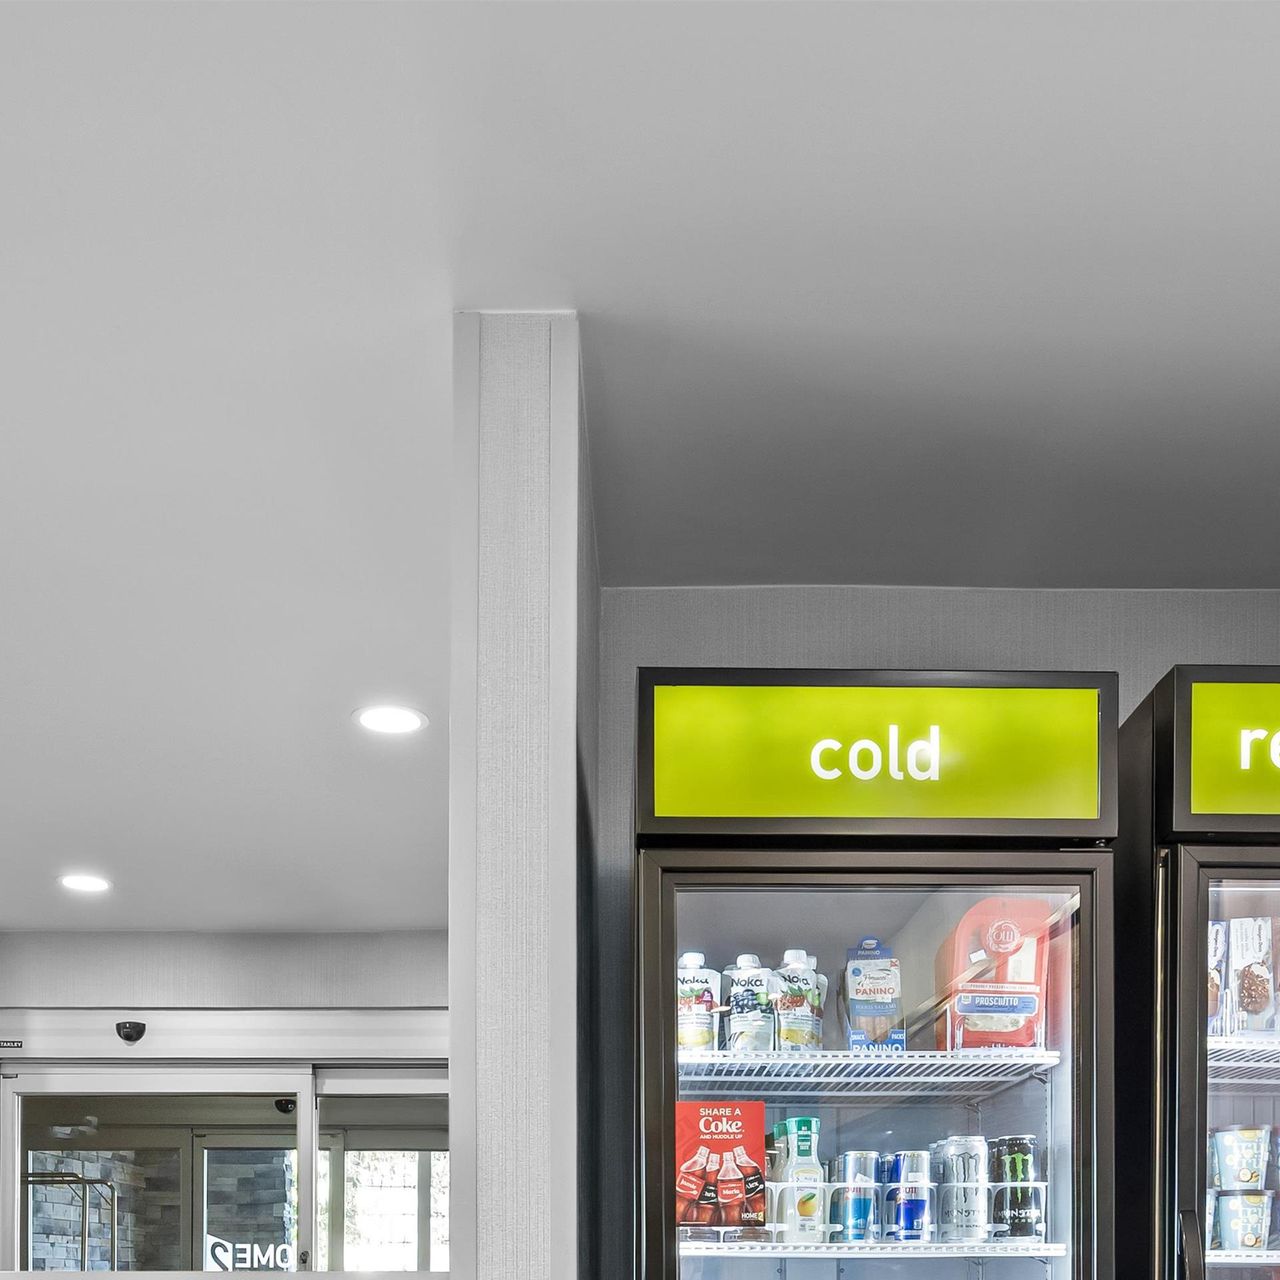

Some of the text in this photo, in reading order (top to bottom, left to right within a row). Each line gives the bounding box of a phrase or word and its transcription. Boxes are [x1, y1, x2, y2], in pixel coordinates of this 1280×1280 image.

[810, 725, 940, 781] cold
[731, 978, 764, 987] Noka
[855, 987, 895, 995] PANINO
[975, 996, 1018, 1006] PROSCIUTTO
[853, 1043, 902, 1051] PANINO
[699, 1108, 732, 1116] SHARE
[698, 1117, 743, 1133] Coke
